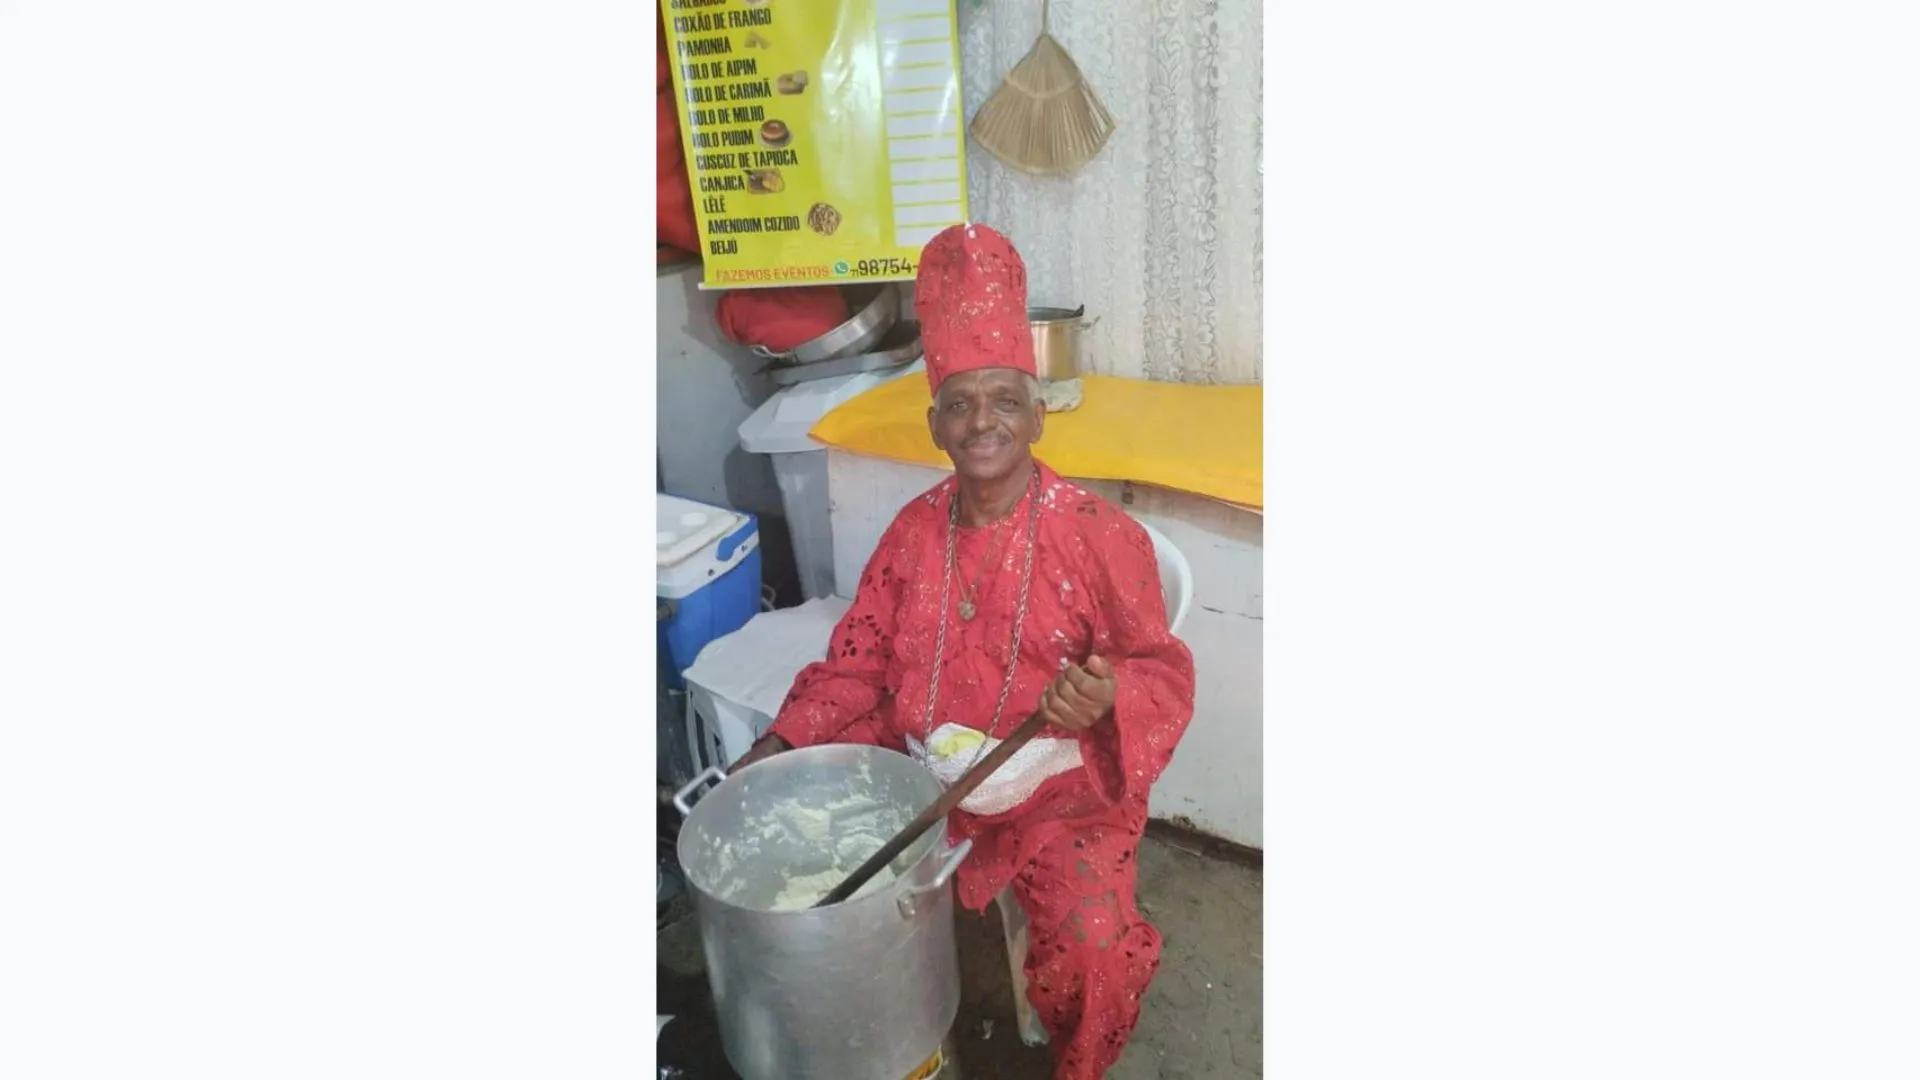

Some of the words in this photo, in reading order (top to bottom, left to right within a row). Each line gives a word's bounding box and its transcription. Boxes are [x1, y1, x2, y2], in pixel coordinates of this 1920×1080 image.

[713, 12, 727, 30] DE
[728, 8, 772, 28] FRANGO
[711, 61, 725, 79] DE
[726, 58, 757, 77] AIPIM
[714, 84, 728, 101] DE
[729, 78, 772, 100] CARIMÃ
[718, 106, 731, 125] DE
[733, 105, 765, 122] MILHO
[721, 129, 754, 147] PUDIM
[696, 153, 735, 170] CUSCUZ
[738, 152, 752, 168] DE
[753, 149, 798, 167] TAPIOCA
[700, 174, 745, 192] CANJICA
[708, 217, 762, 235] AMENDOIM
[764, 215, 800, 232] COZIDO
[716, 268, 771, 281] FAZEMOS
[773, 265, 829, 279] EVENTOS
